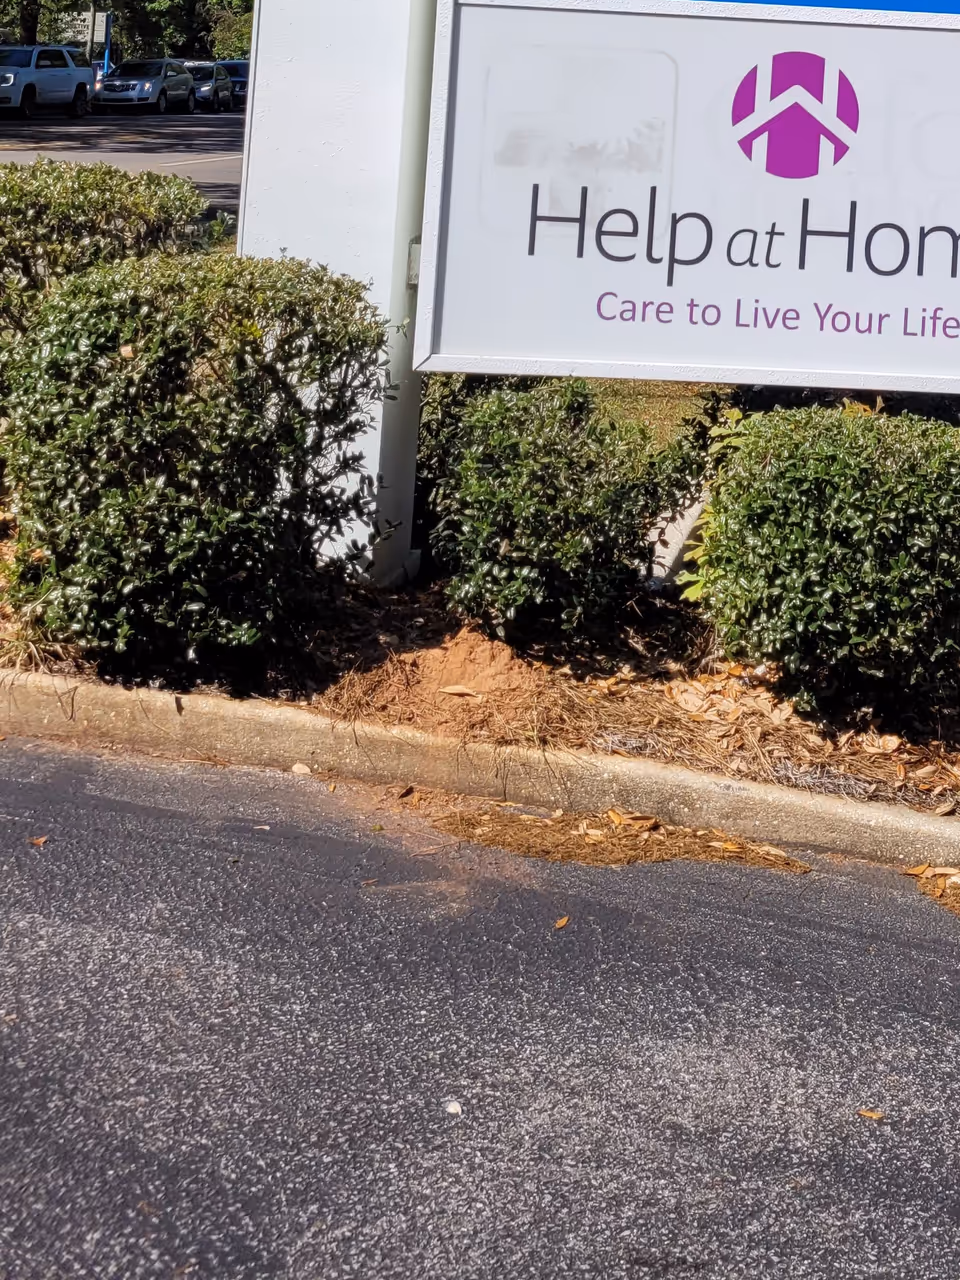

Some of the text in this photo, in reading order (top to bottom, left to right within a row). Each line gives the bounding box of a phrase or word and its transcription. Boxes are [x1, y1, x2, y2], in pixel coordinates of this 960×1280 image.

[527, 183, 713, 287] Help
[726, 221, 786, 269] at
[596, 292, 674, 325] Care
[687, 299, 722, 327] to
[735, 300, 801, 331] Live
[814, 303, 891, 335] Your
